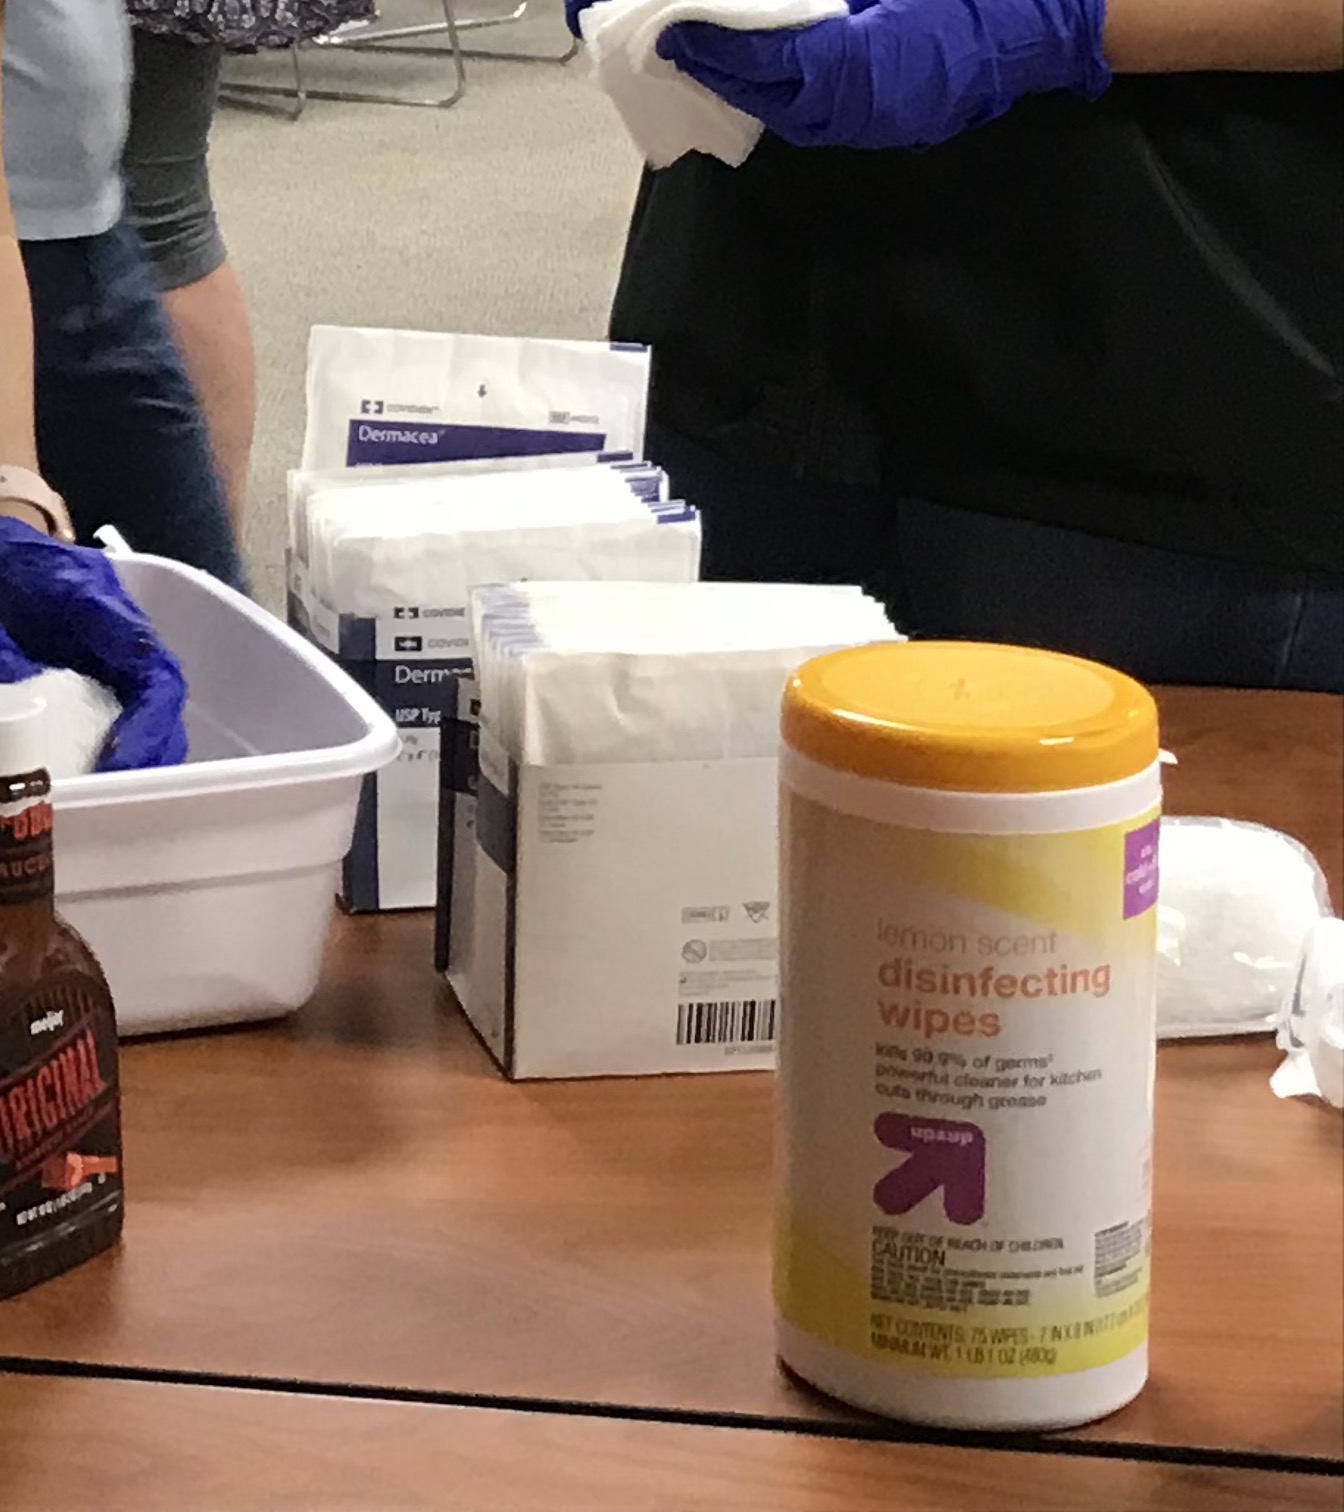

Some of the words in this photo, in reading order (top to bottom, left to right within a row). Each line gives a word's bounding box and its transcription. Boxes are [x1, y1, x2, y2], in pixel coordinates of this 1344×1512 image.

[878, 918, 967, 953] lemon
[977, 932, 1057, 957] scent
[878, 958, 1110, 998] disinfecting
[877, 999, 1001, 1038] wipes
[972, 1054, 990, 1069] of
[875, 1063, 949, 1084] powerful
[954, 1072, 1019, 1088] cleaner
[1024, 1073, 1046, 1088] for
[1050, 1068, 1102, 1086] kitchen
[874, 1083, 911, 1099] cuts
[916, 1086, 984, 1110] through
[988, 1094, 1048, 1109] grease
[872, 1239, 946, 1266] CAUTION
